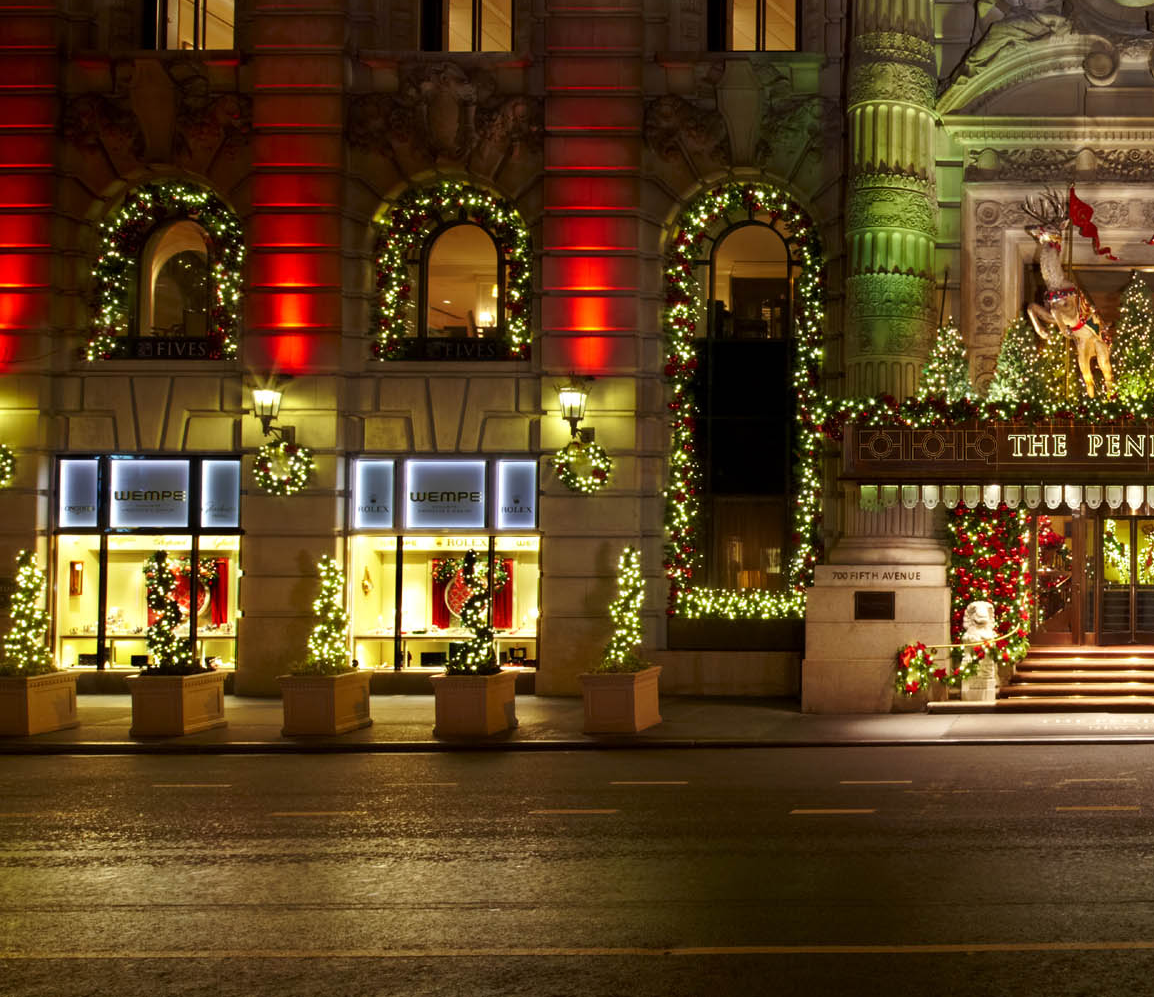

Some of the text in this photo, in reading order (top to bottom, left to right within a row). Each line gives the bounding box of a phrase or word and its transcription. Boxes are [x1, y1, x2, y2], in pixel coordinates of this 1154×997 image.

[157, 342, 206, 356] FIVES
[446, 343, 496, 357] FIVES
[1007, 434, 1068, 457] THE
[114, 490, 187, 502] WEMPE
[409, 491, 483, 503] WEMPE
[358, 506, 389, 514] ROLEX
[501, 506, 532, 514] ROLEX
[447, 538, 487, 548] ROLEX
[832, 571, 921, 581] 700 FIFTH AVENUE
